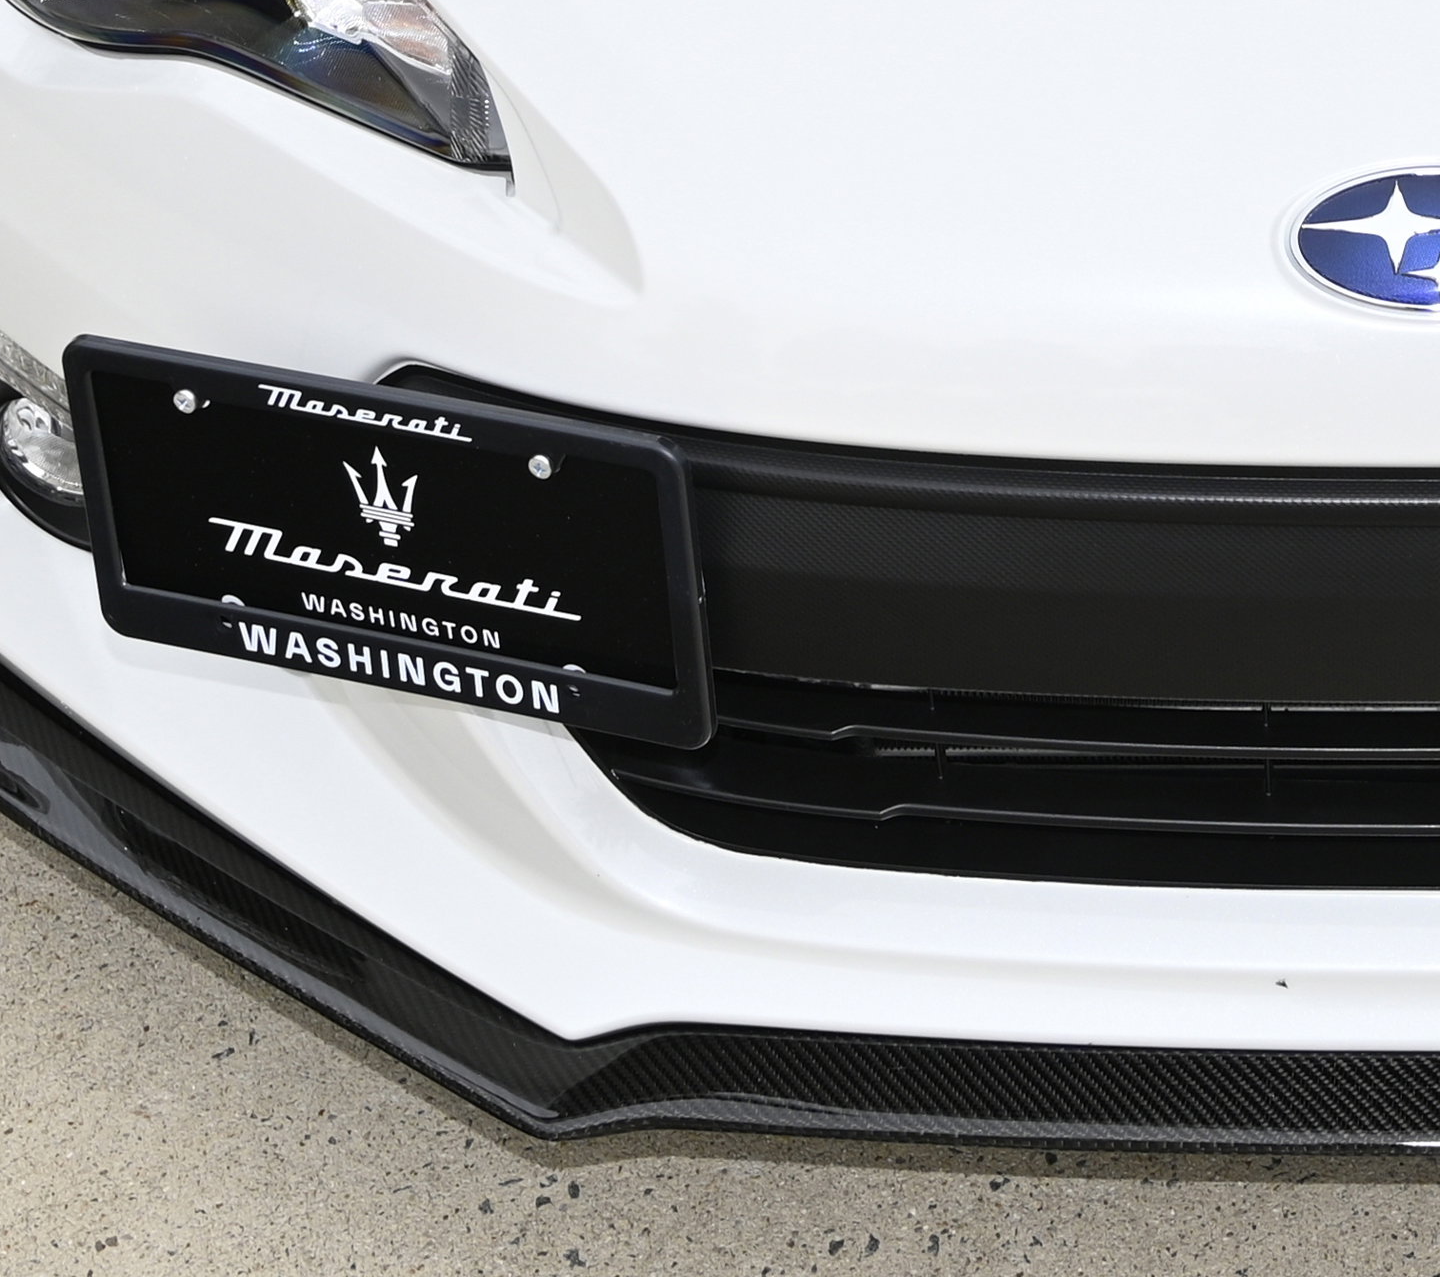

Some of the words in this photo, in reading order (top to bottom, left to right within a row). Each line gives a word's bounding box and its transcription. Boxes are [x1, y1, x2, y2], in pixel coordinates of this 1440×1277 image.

[258, 383, 473, 443] Maserati
[207, 516, 582, 622] Maserati
[300, 592, 501, 649] WASHINGTON
[238, 621, 561, 715] WASHINGTON
